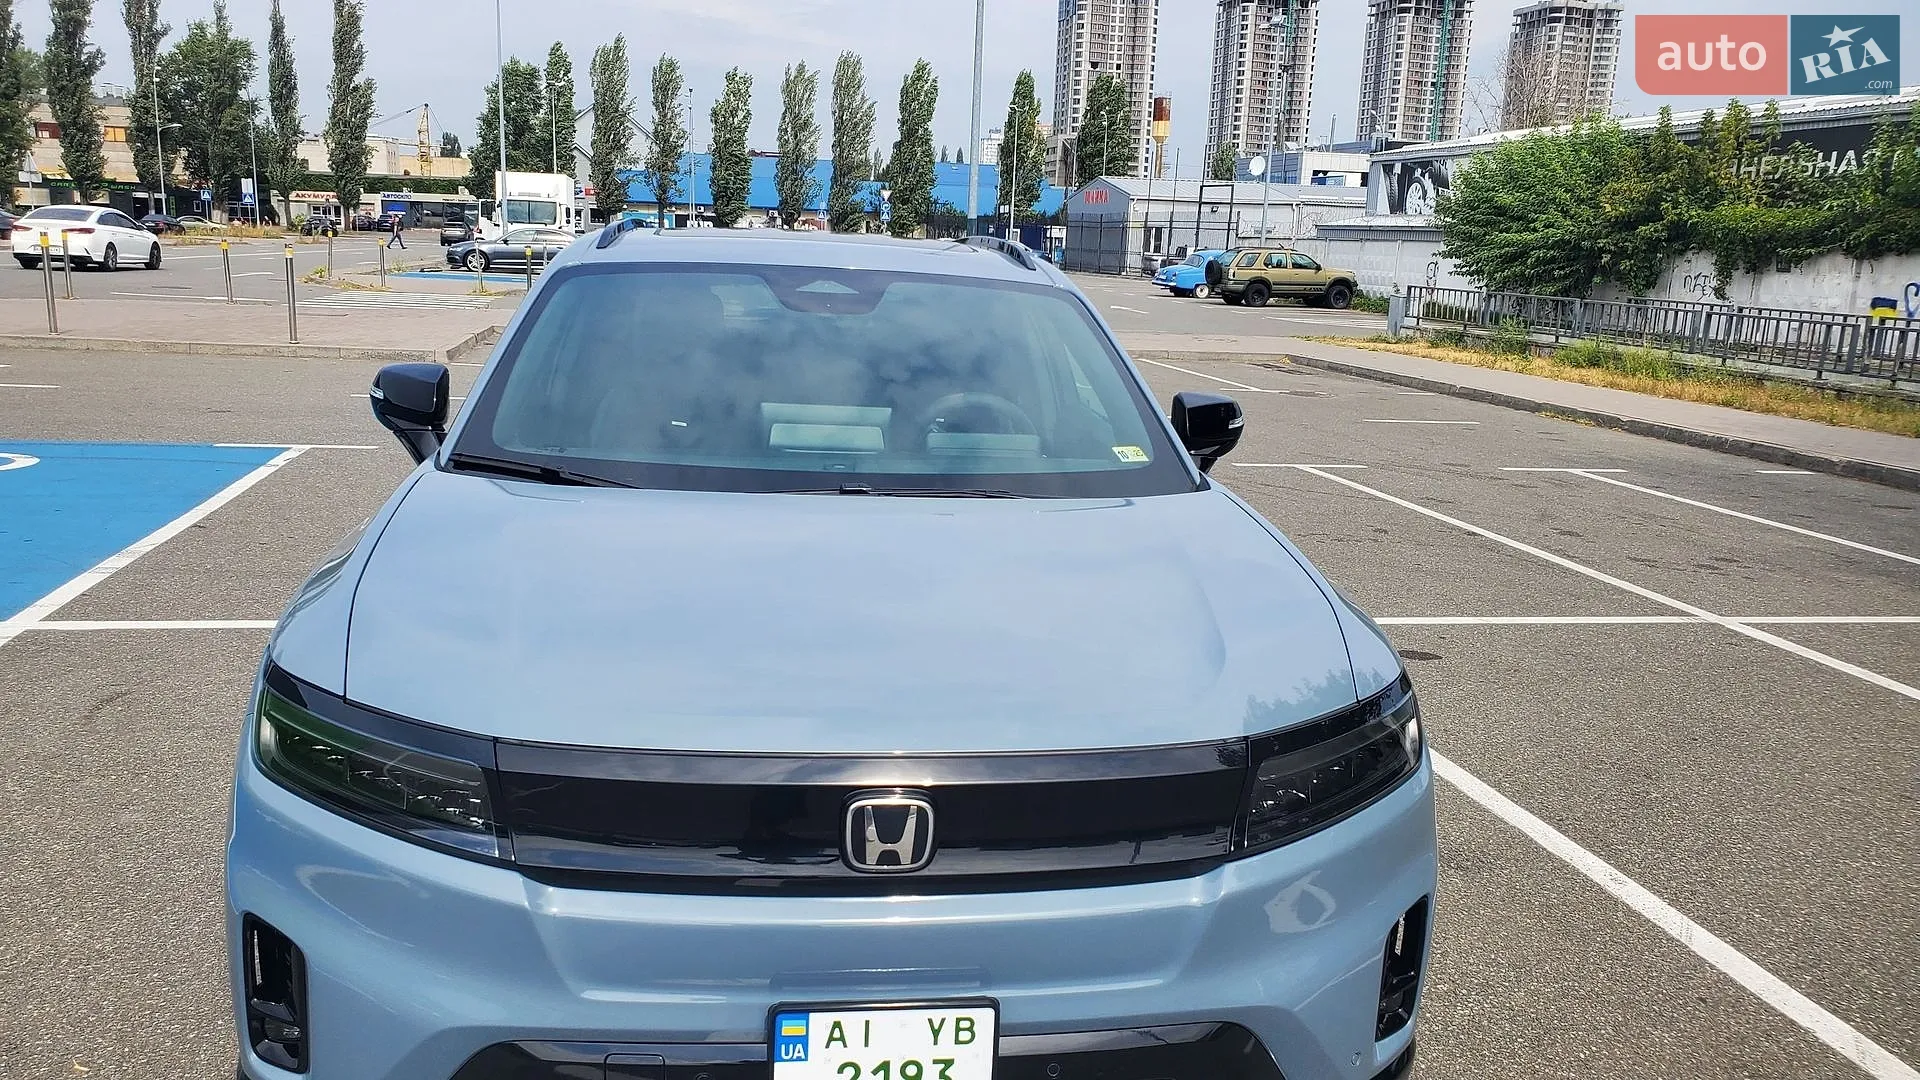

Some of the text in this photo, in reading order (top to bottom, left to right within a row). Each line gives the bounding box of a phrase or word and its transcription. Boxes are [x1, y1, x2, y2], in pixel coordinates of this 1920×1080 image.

[825, 1016, 976, 1049] AI YB
[780, 1043, 806, 1060] UA
